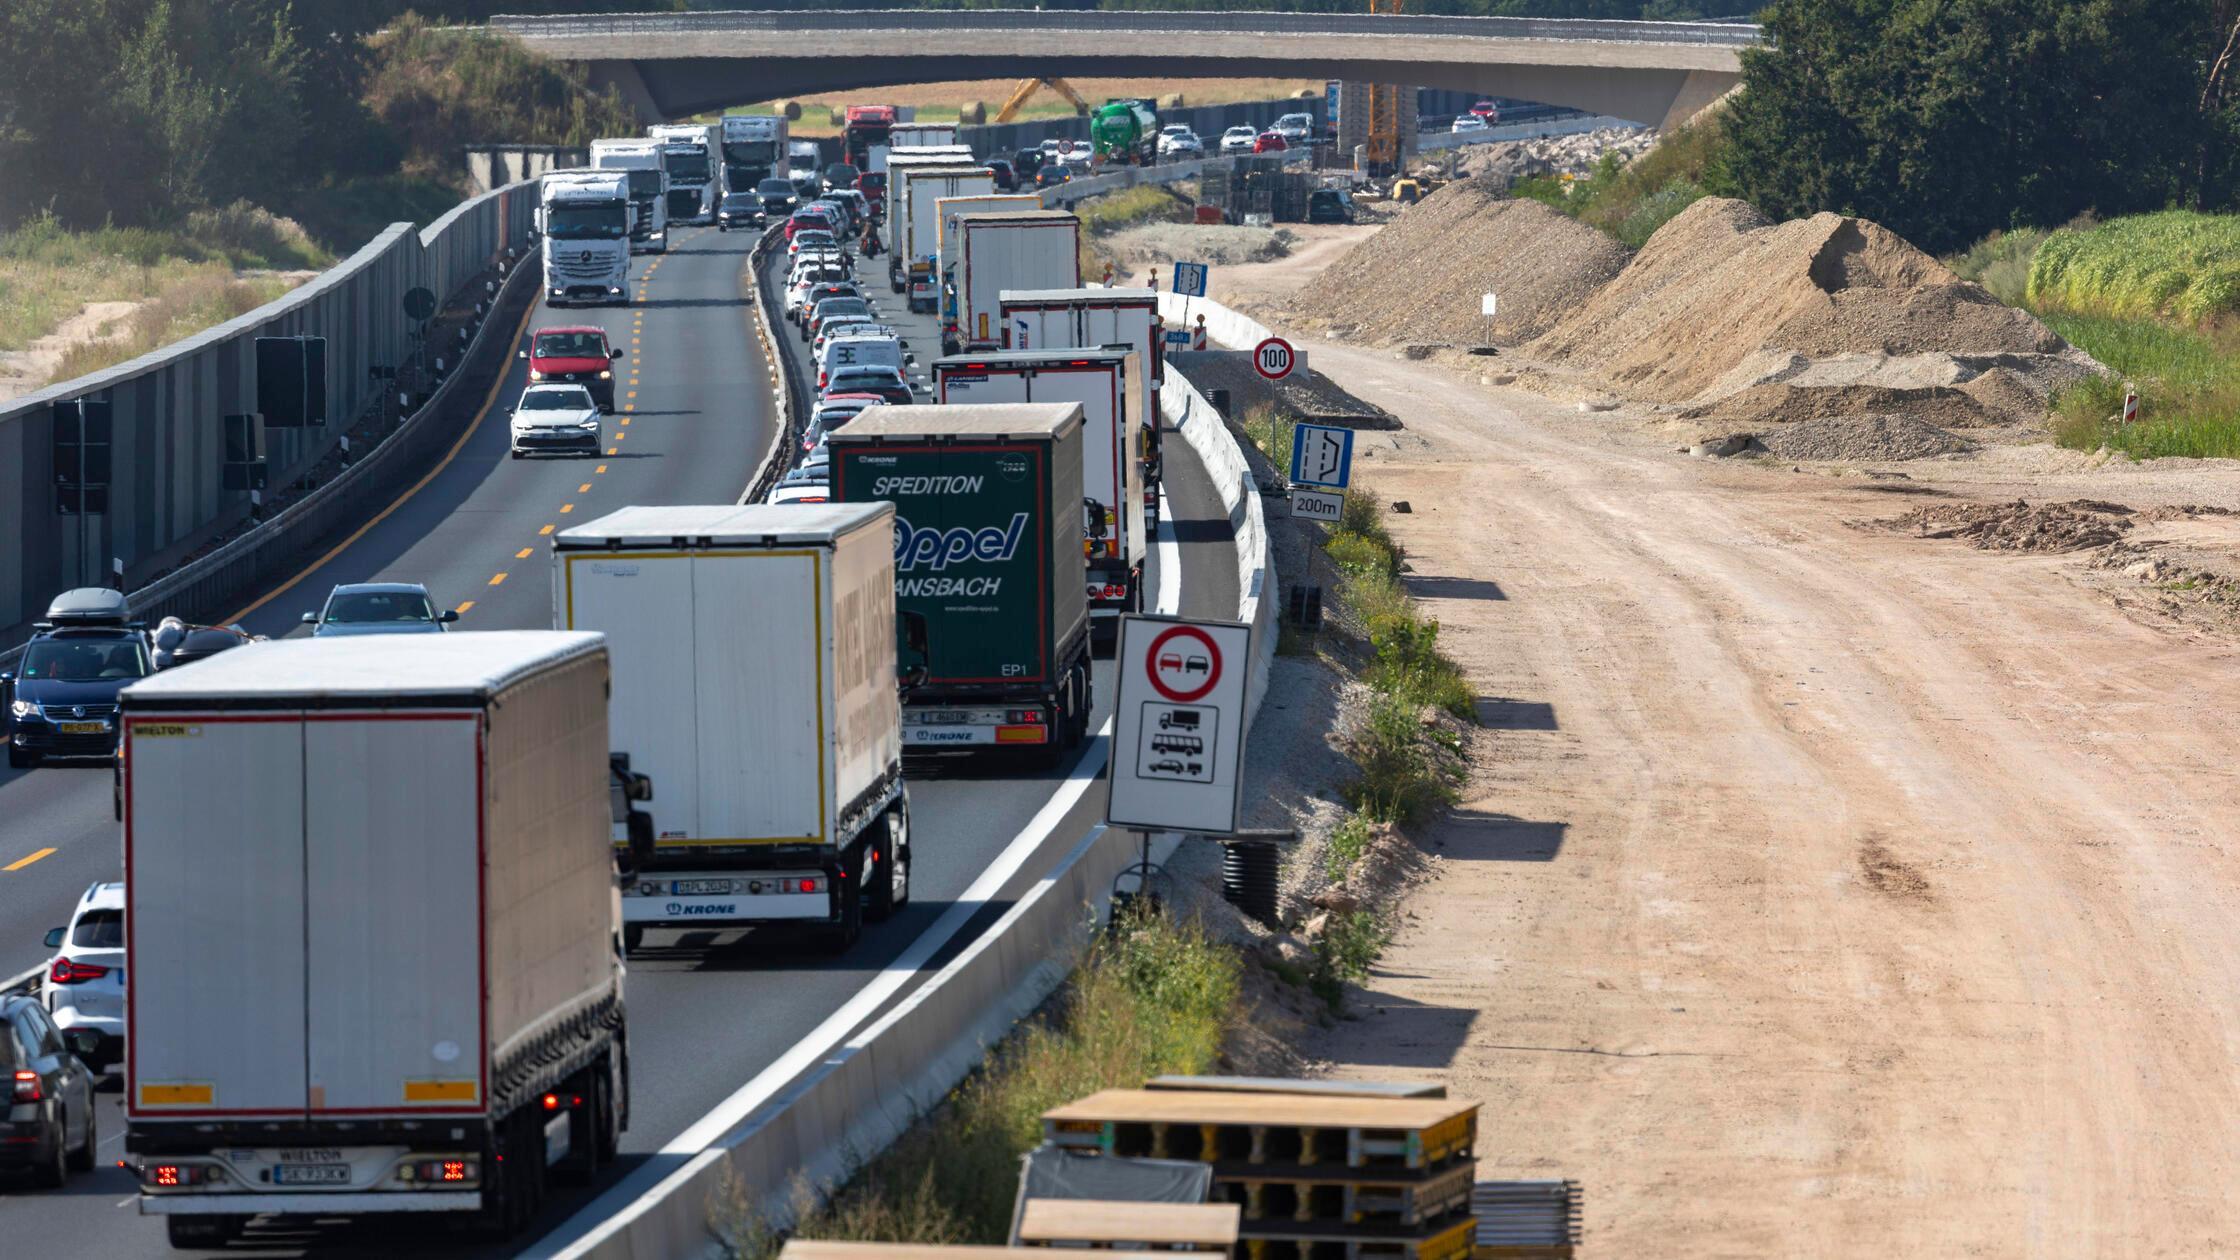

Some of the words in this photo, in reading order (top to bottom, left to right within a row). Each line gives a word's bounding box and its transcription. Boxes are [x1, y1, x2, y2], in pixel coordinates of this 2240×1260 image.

[1261, 348, 1288, 368] 100
[872, 475, 984, 496] SPEDITION
[894, 577, 1002, 597] ANSBACH
[1001, 664, 1027, 677] EP1
[134, 725, 185, 735] WIELTON
[929, 731, 974, 741] KRONE
[683, 904, 736, 915] KRONE
[280, 1149, 342, 1161] WIELTON
